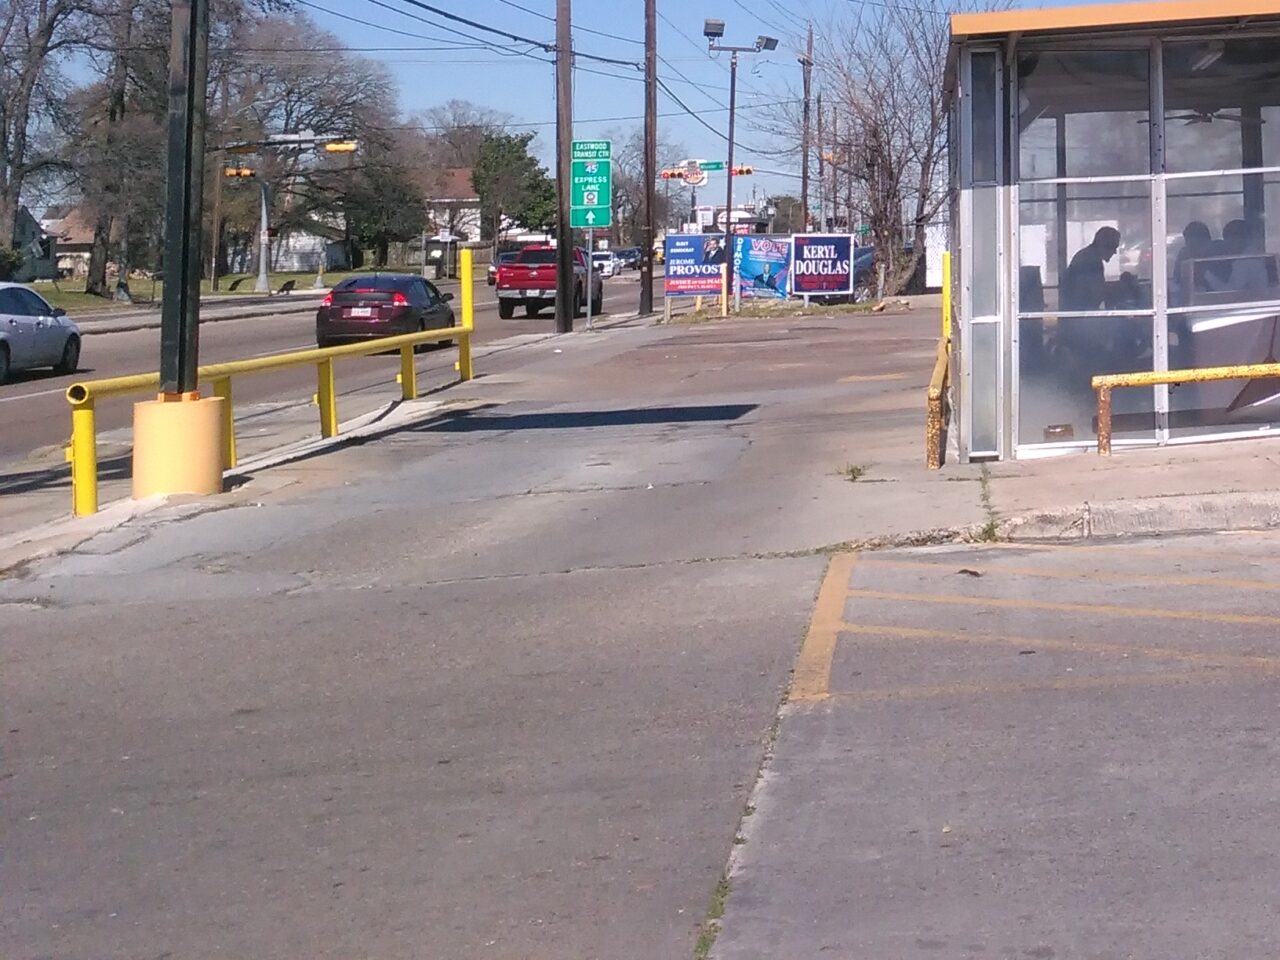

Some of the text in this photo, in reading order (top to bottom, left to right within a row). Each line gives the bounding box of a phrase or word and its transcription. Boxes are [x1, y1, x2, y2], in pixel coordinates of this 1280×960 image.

[575, 142, 608, 150] EASTWOOD
[574, 150, 610, 158] TRANSIT CTR
[585, 164, 599, 175] 45
[574, 176, 608, 184] EXPRESS
[581, 184, 601, 192] LANE
[750, 238, 788, 257] VOTE
[803, 244, 838, 259] KERYL
[795, 259, 850, 276] DOUGLAS
